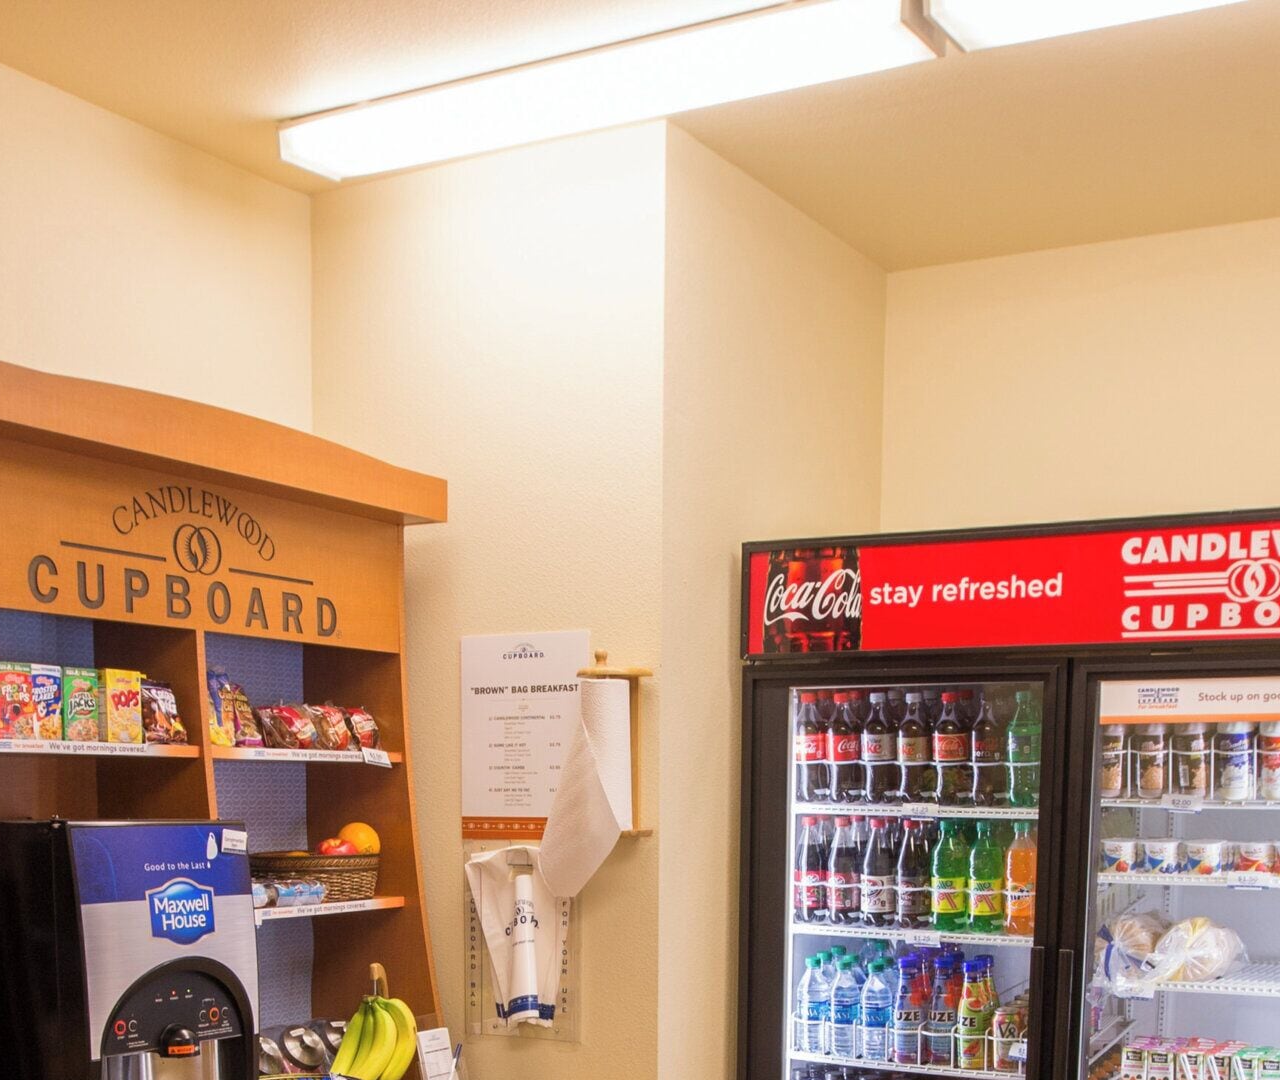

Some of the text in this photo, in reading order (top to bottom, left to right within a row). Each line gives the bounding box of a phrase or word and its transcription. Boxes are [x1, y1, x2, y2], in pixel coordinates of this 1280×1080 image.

[111, 485, 277, 563] CANDLEWOOD
[27, 554, 338, 639] CUPBOARD
[764, 568, 863, 626] Coca-Cola
[869, 573, 1063, 608] stay refreshed
[502, 650, 545, 661] CUPBOARD
[511, 684, 529, 694] BAG
[530, 682, 580, 694] BREAKFAST
[1198, 691, 1227, 702] Stock
[1230, 693, 1244, 704] up
[1246, 692, 1261, 702] on
[68, 698, 96, 718] JACKS
[111, 690, 140, 712] POPS
[49, 742, 72, 752] We've
[73, 744, 85, 754] got
[86, 743, 118, 755] mornings
[118, 743, 147, 754] covered.
[318, 752, 341, 761] mornings
[144, 860, 205, 873] Good to the Last
[153, 892, 210, 917] Maxwell
[323, 904, 346, 914] mornings
[161, 909, 207, 932] House
[561, 900, 569, 1014] FOR YOUR USE
[469, 981, 477, 1008] BAG
